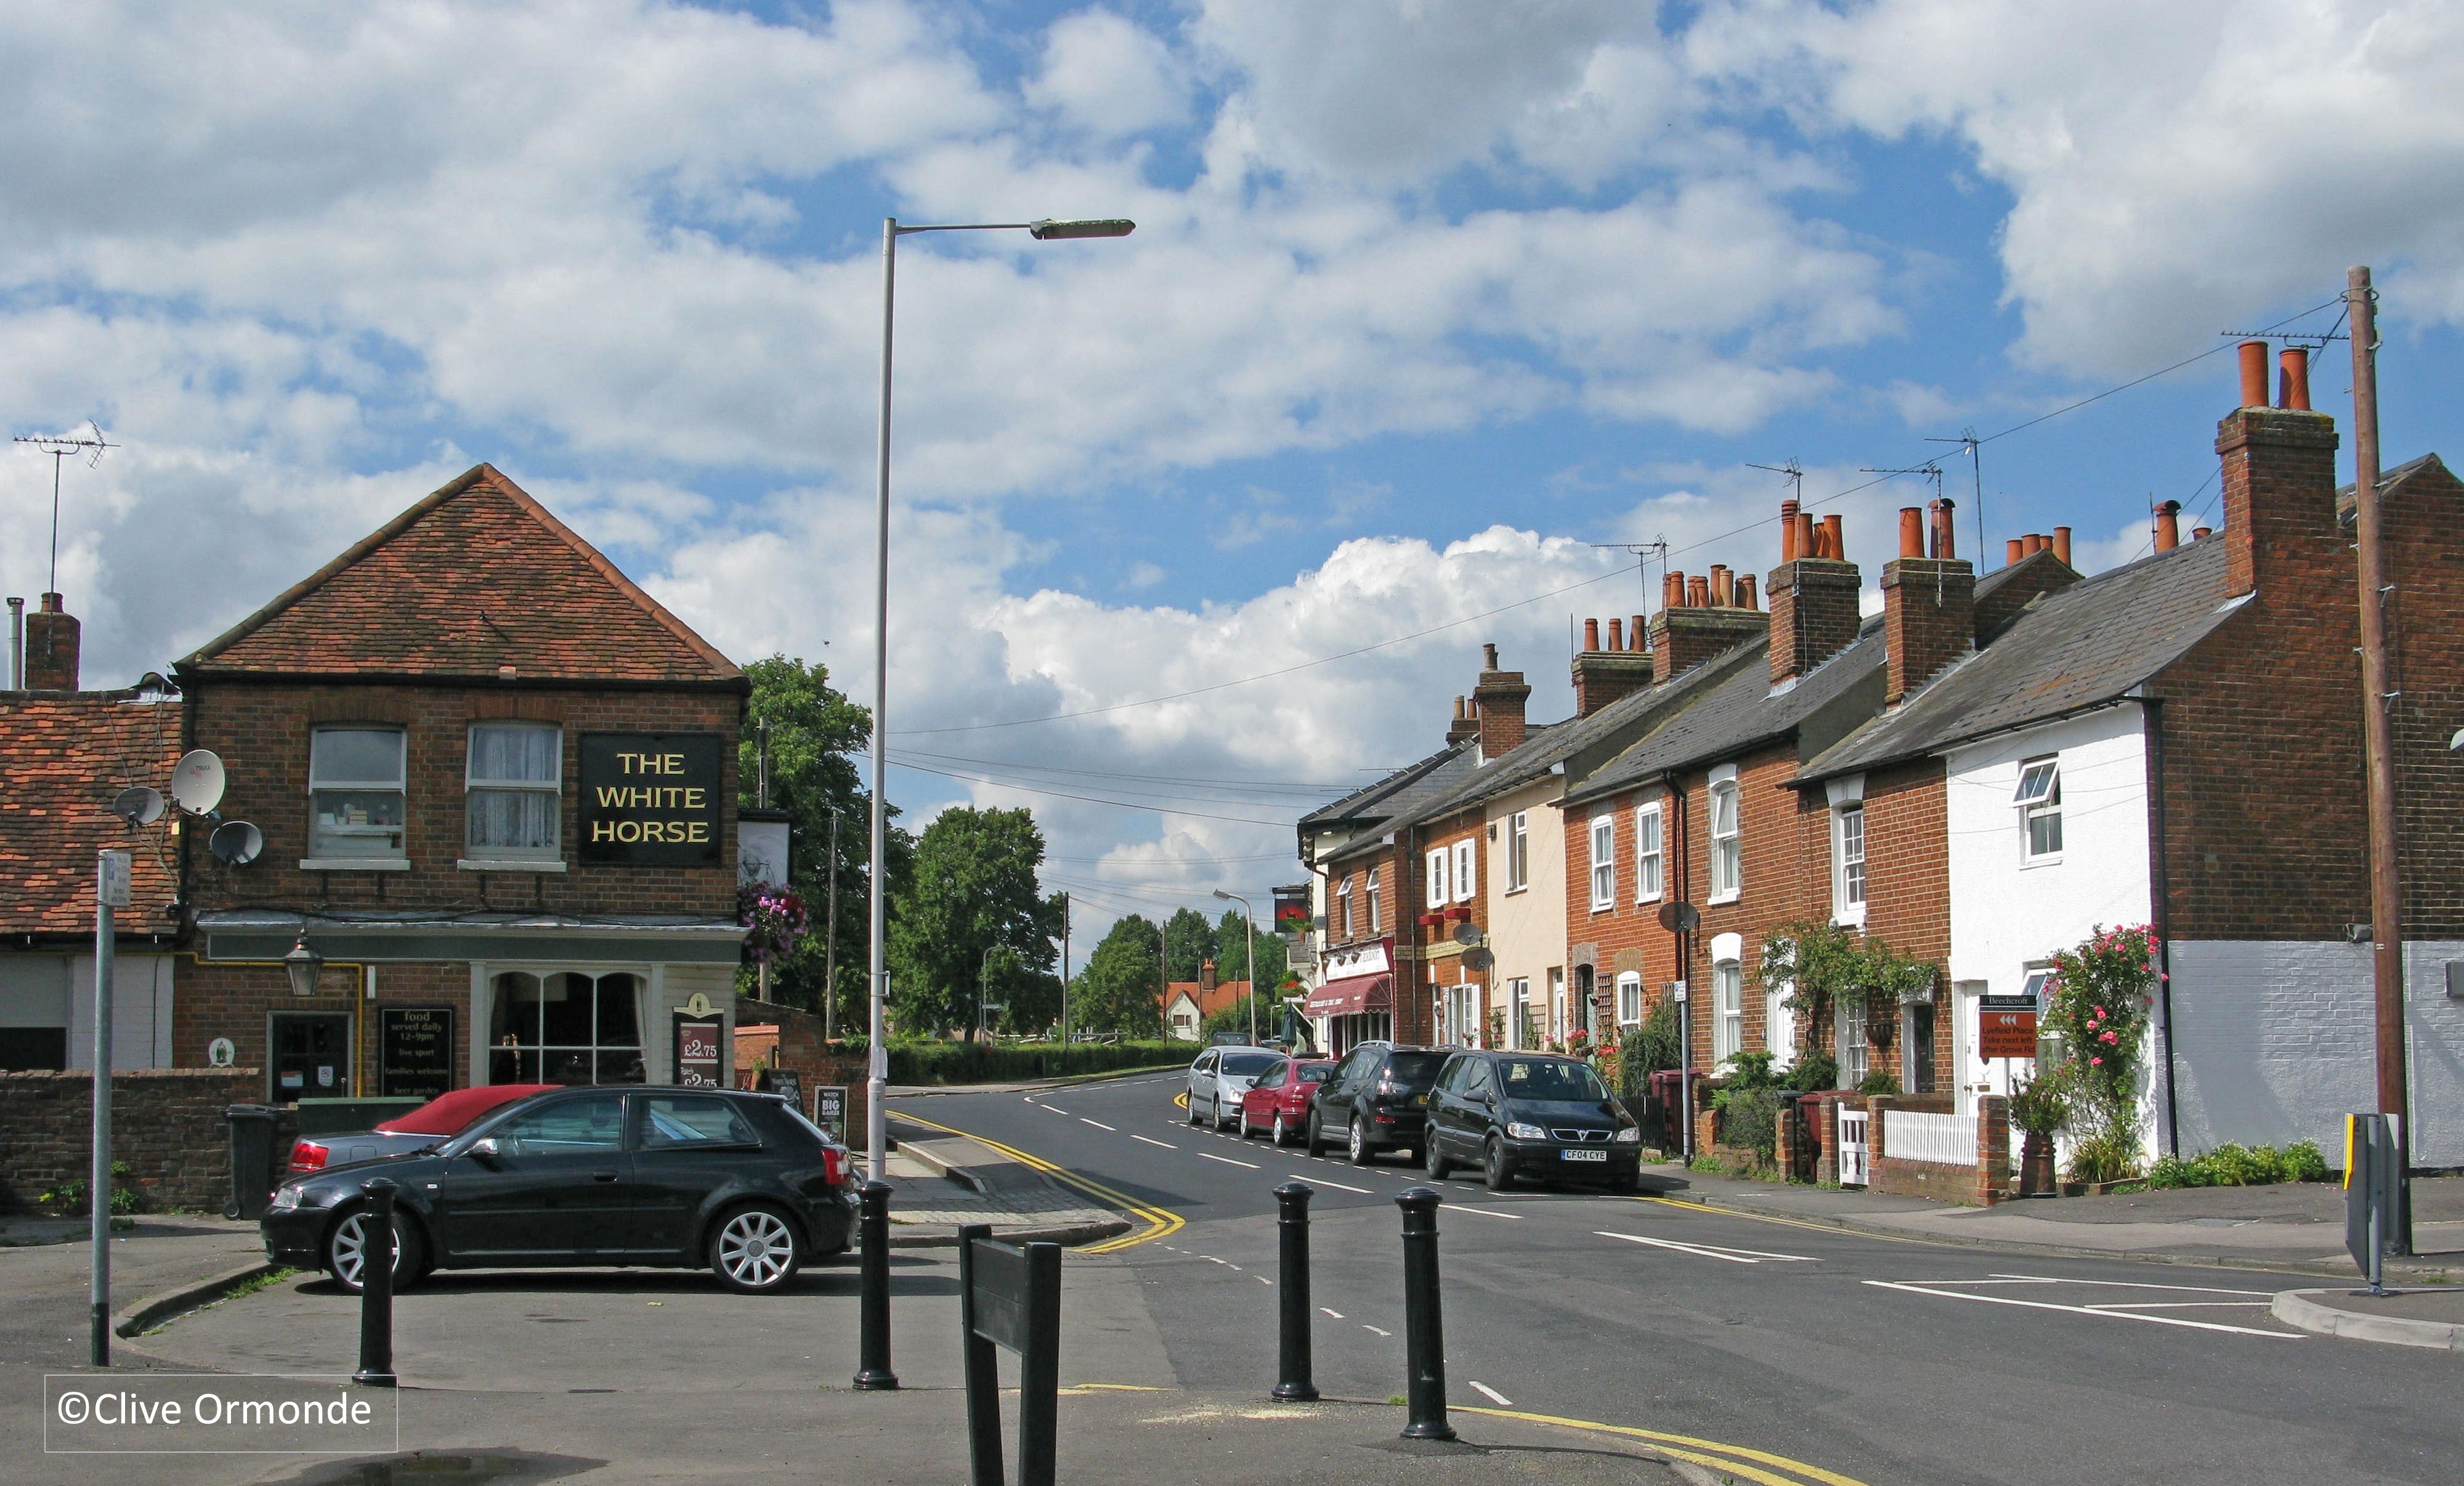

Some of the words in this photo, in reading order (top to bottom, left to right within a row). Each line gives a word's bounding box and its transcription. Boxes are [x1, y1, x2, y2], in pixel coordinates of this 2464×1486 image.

[617, 753, 686, 775] THE
[596, 787, 707, 809] WHITE
[591, 821, 710, 843] HORSE
[1988, 996, 2028, 1004] Beechcroft
[405, 1011, 430, 1021] food
[391, 1023, 419, 1031] served
[422, 1023, 442, 1033] daily
[400, 1033, 435, 1042] 12-9pm
[684, 1039, 717, 1057] £2.75
[415, 1049, 434, 1058] sport
[385, 1066, 415, 1075] families
[417, 1067, 448, 1075] welcome
[394, 1086, 410, 1095] beer
[413, 1086, 439, 1096] garden
[822, 1100, 840, 1110] BIG
[1566, 1150, 1587, 1159] CF04
[1590, 1151, 1605, 1159] CYE
